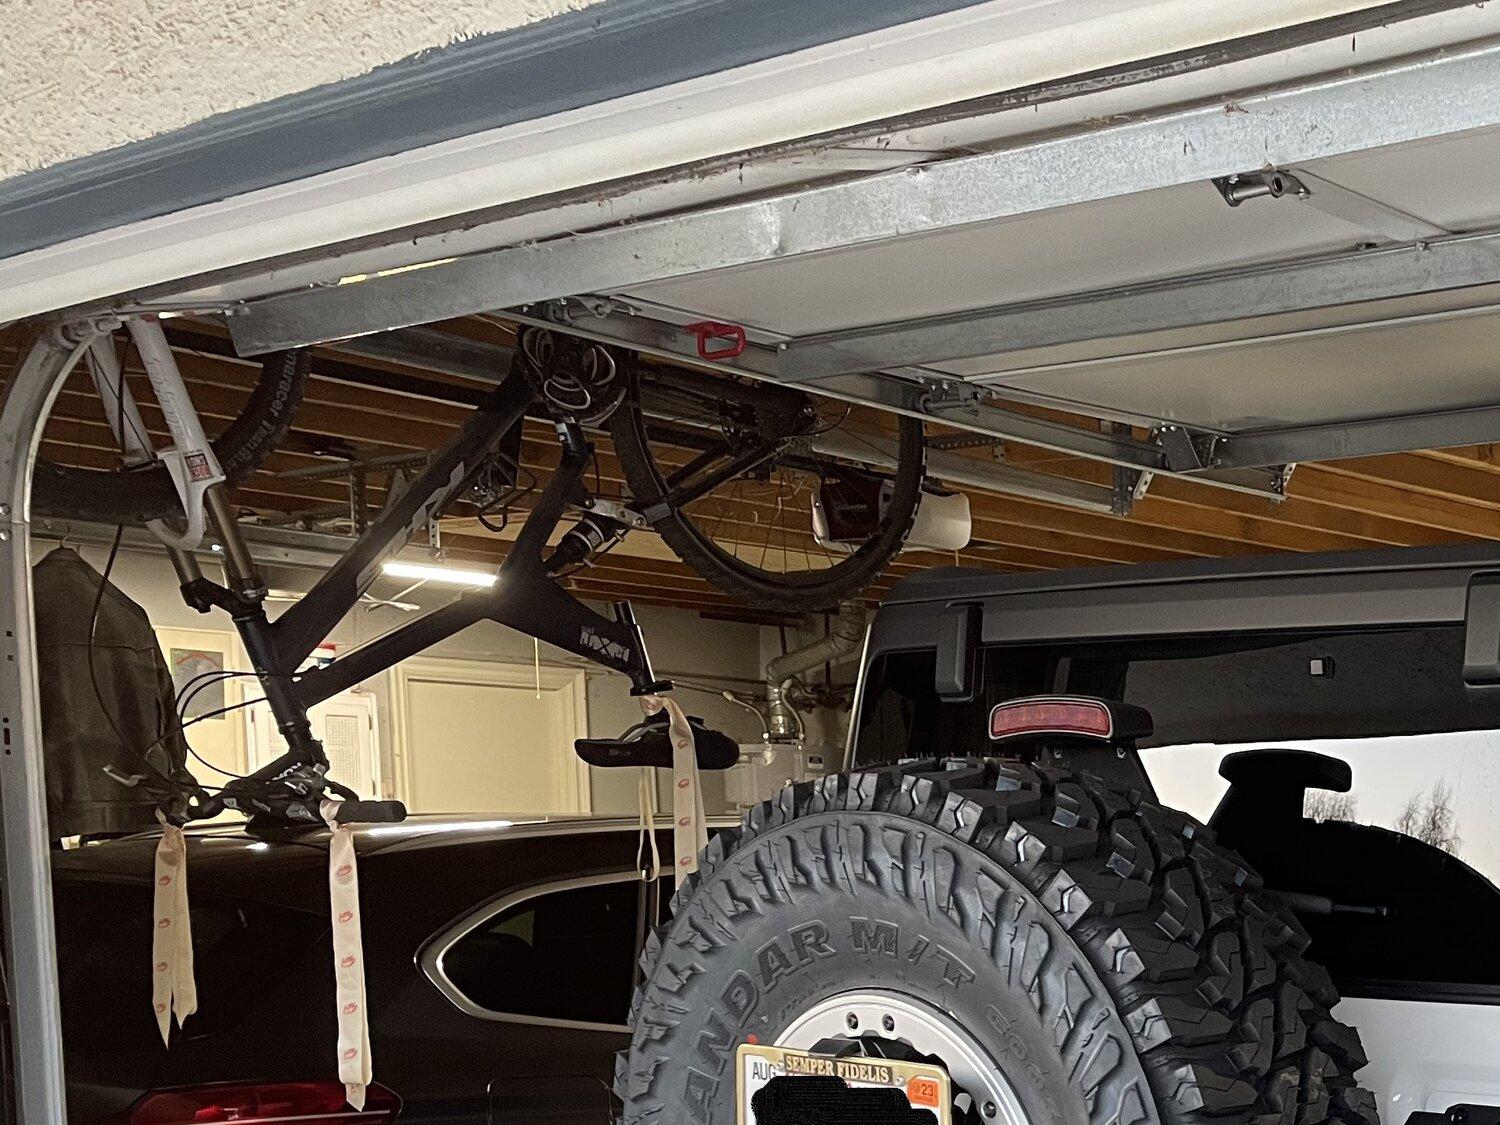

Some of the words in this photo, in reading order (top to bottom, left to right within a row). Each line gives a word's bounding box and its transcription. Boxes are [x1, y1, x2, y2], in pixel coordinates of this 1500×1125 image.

[751, 1061, 776, 1081] AUG
[785, 1055, 835, 1077] SEMPER
[836, 1061, 891, 1084] FIDELIS
[921, 1083, 935, 1097] 23
